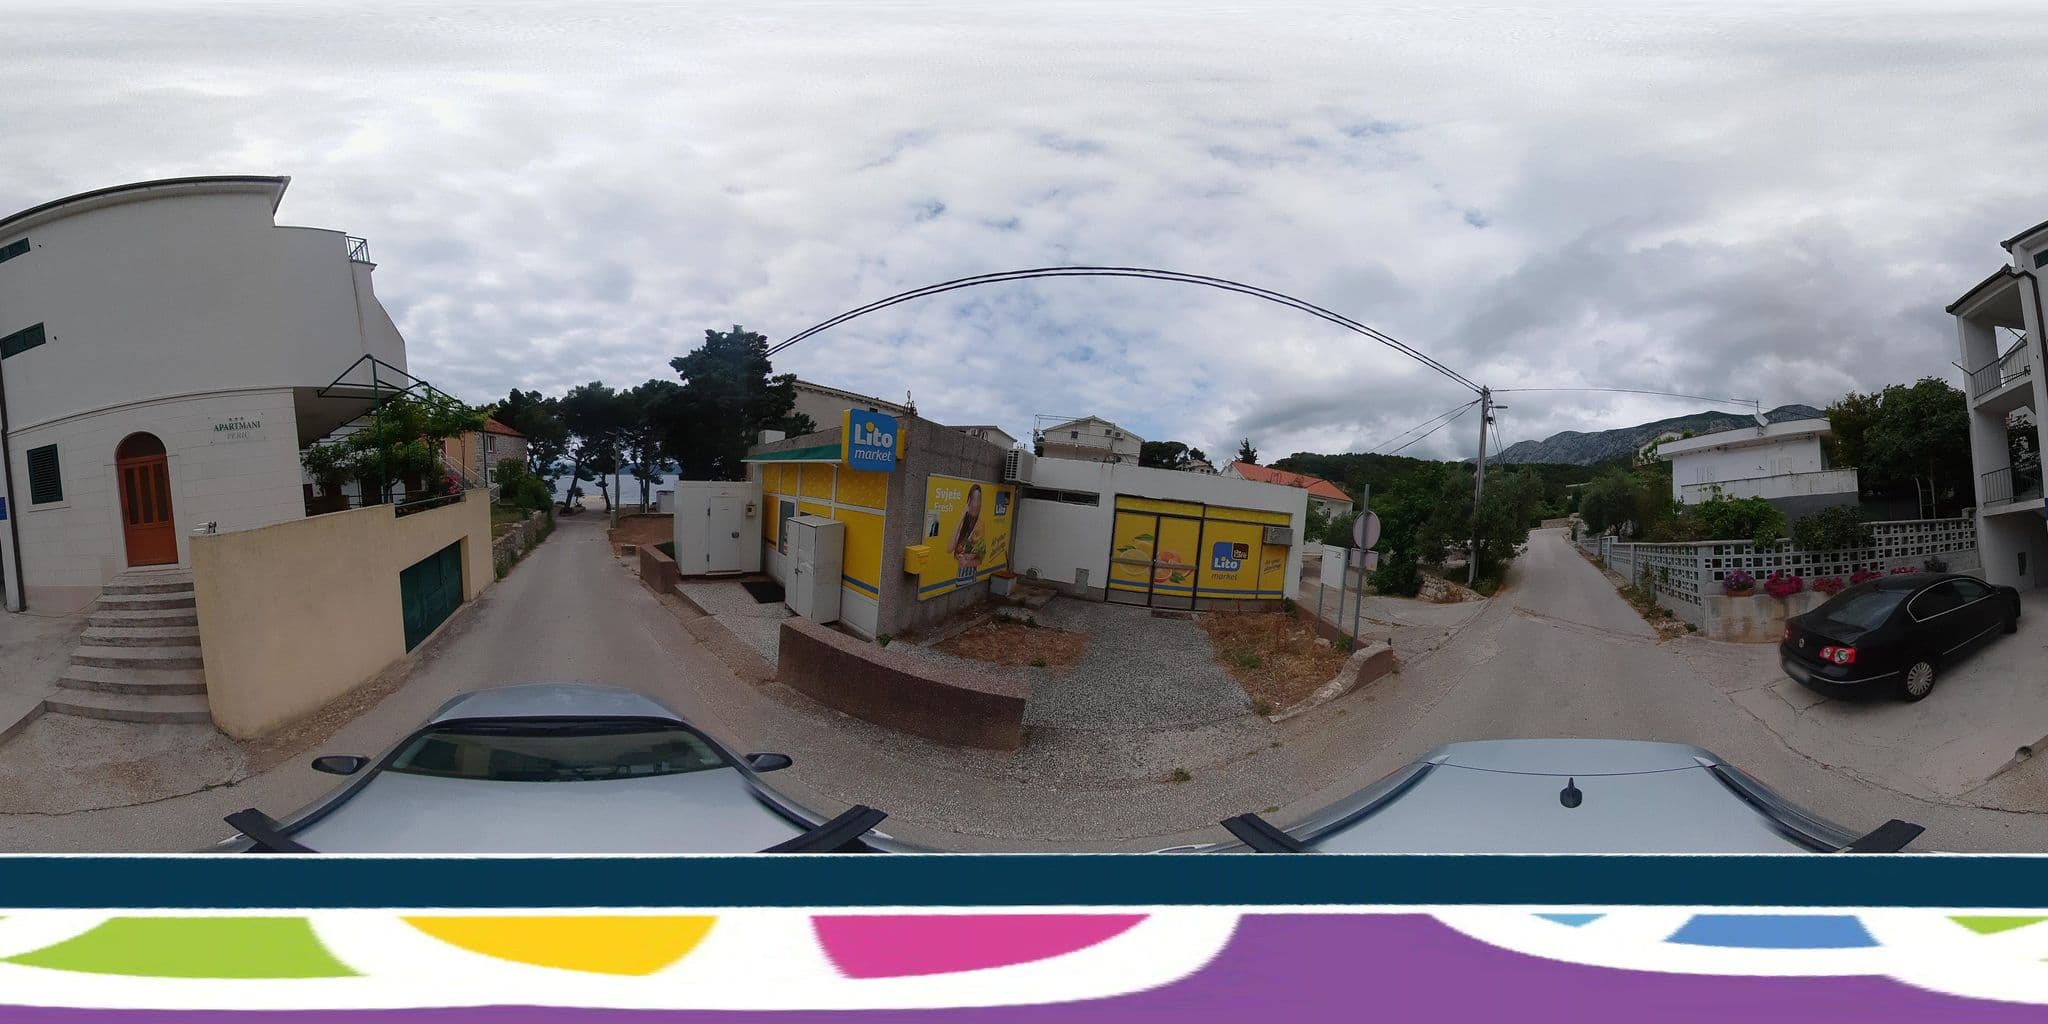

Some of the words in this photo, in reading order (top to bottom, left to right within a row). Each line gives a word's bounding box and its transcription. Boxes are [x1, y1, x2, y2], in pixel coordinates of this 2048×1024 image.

[213, 420, 261, 432] APARTMANI
[854, 422, 894, 448] Lito
[854, 449, 893, 462] market
[1214, 556, 1238, 569] Lito
[1211, 573, 1238, 581] market
